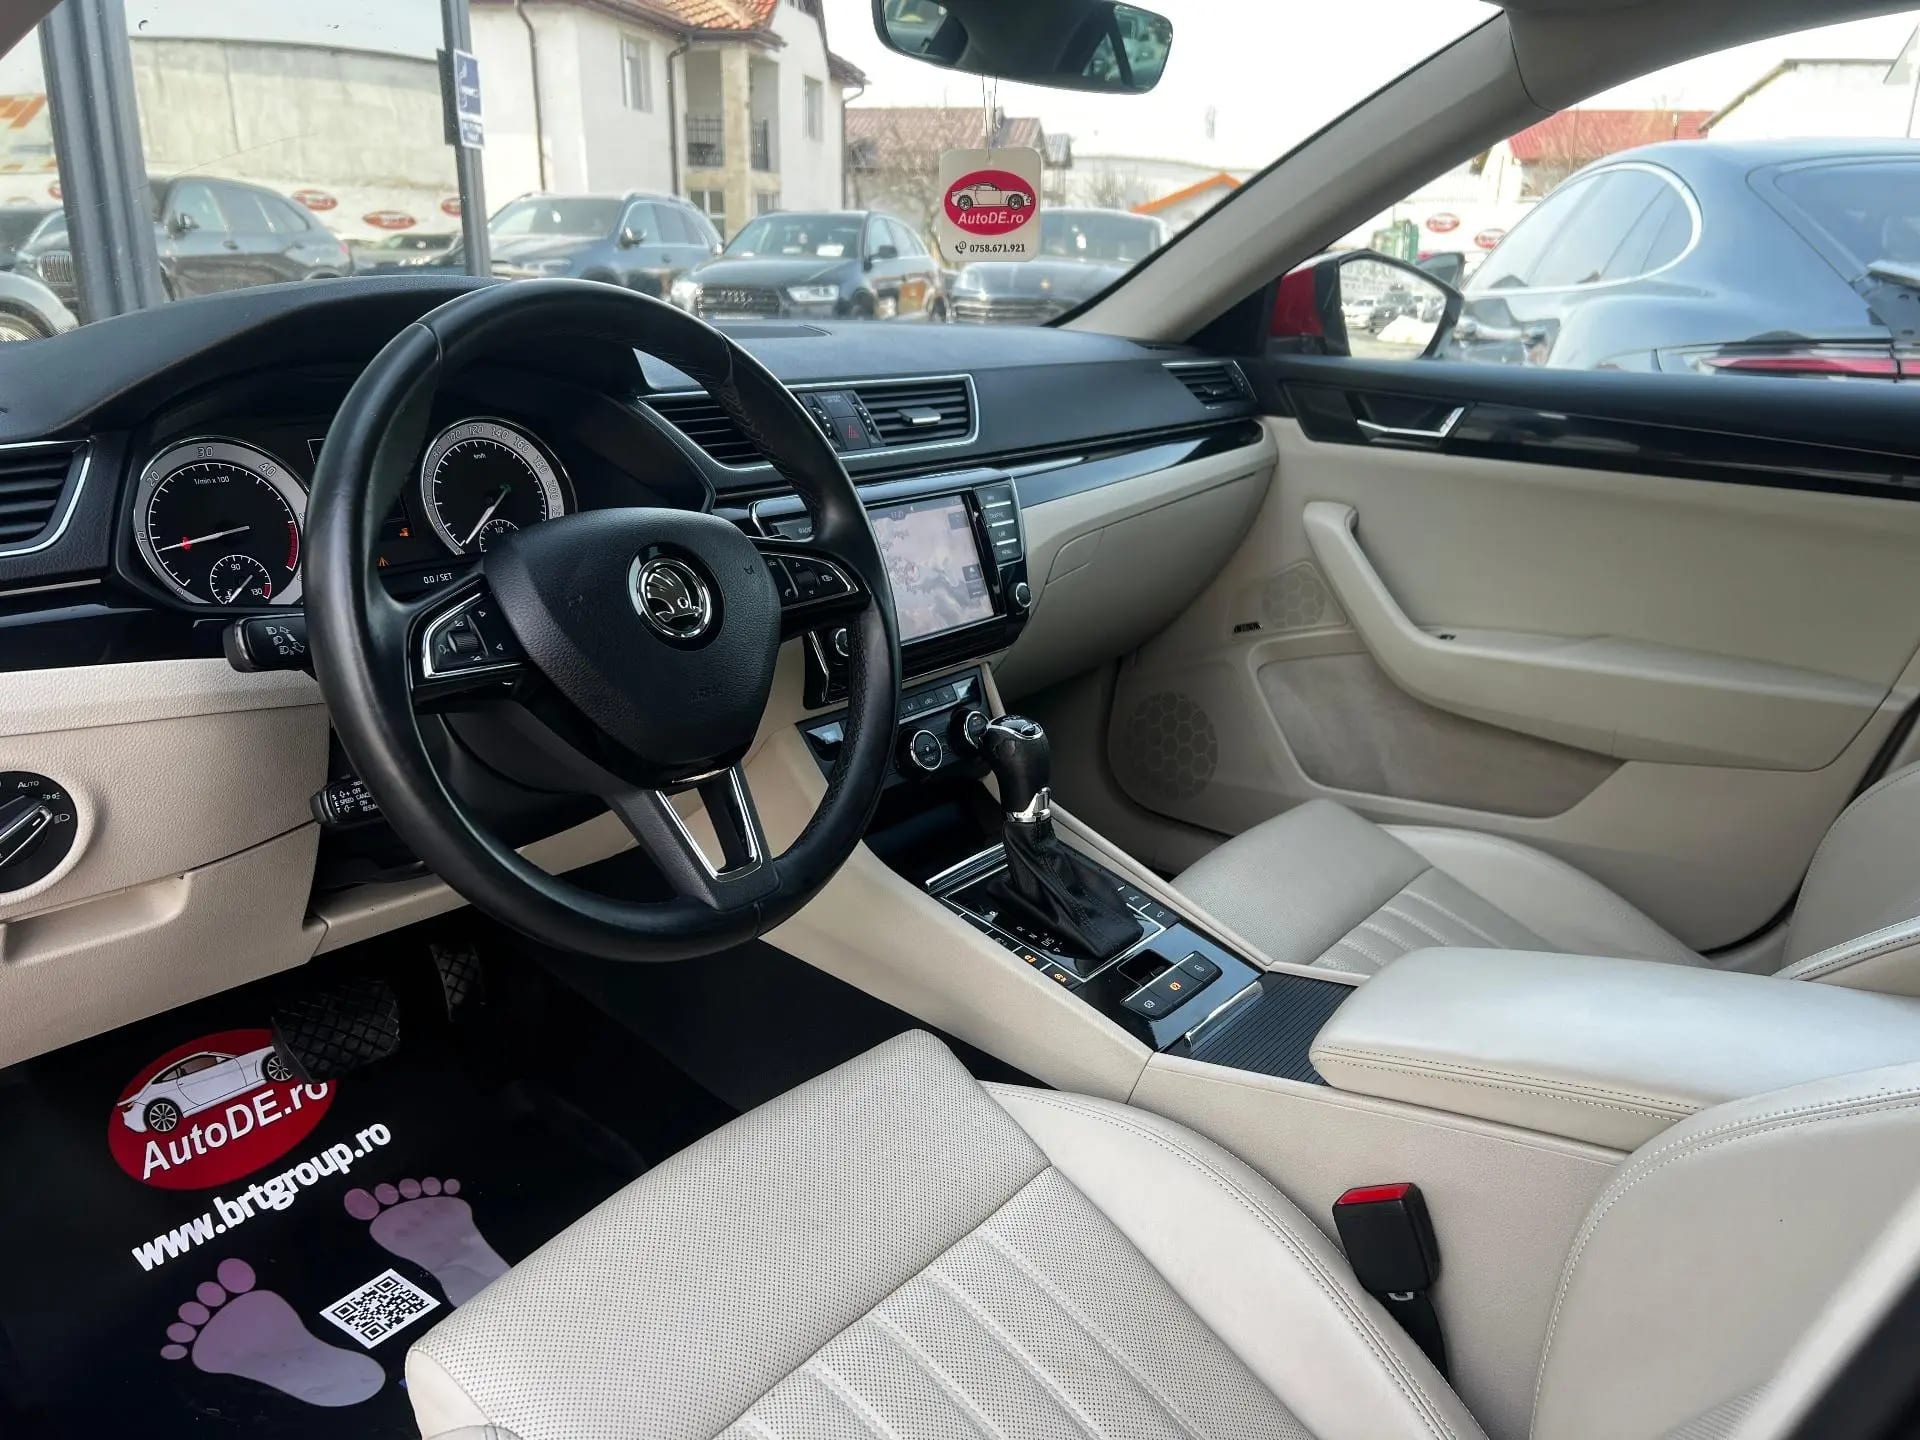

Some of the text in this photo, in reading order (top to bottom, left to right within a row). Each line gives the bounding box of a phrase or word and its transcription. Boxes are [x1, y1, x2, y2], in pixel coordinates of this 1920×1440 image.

[958, 211, 1024, 225] AutoDE.ro
[969, 243, 1026, 253] 0758.671.921
[468, 425, 484, 435] 120
[491, 427, 509, 440] 140
[447, 431, 461, 442] 100
[513, 436, 531, 453] 160
[197, 446, 213, 458] 30
[258, 462, 277, 477] 40
[533, 455, 549, 474] 180
[146, 471, 160, 487] 20
[218, 476, 230, 484] 100
[230, 563, 241, 571] 90
[440, 572, 453, 582] SET
[251, 587, 263, 595] 130
[143, 1080, 329, 1180] AutoDE.ro
[131, 1123, 391, 1272] www.brtgroup.ro
